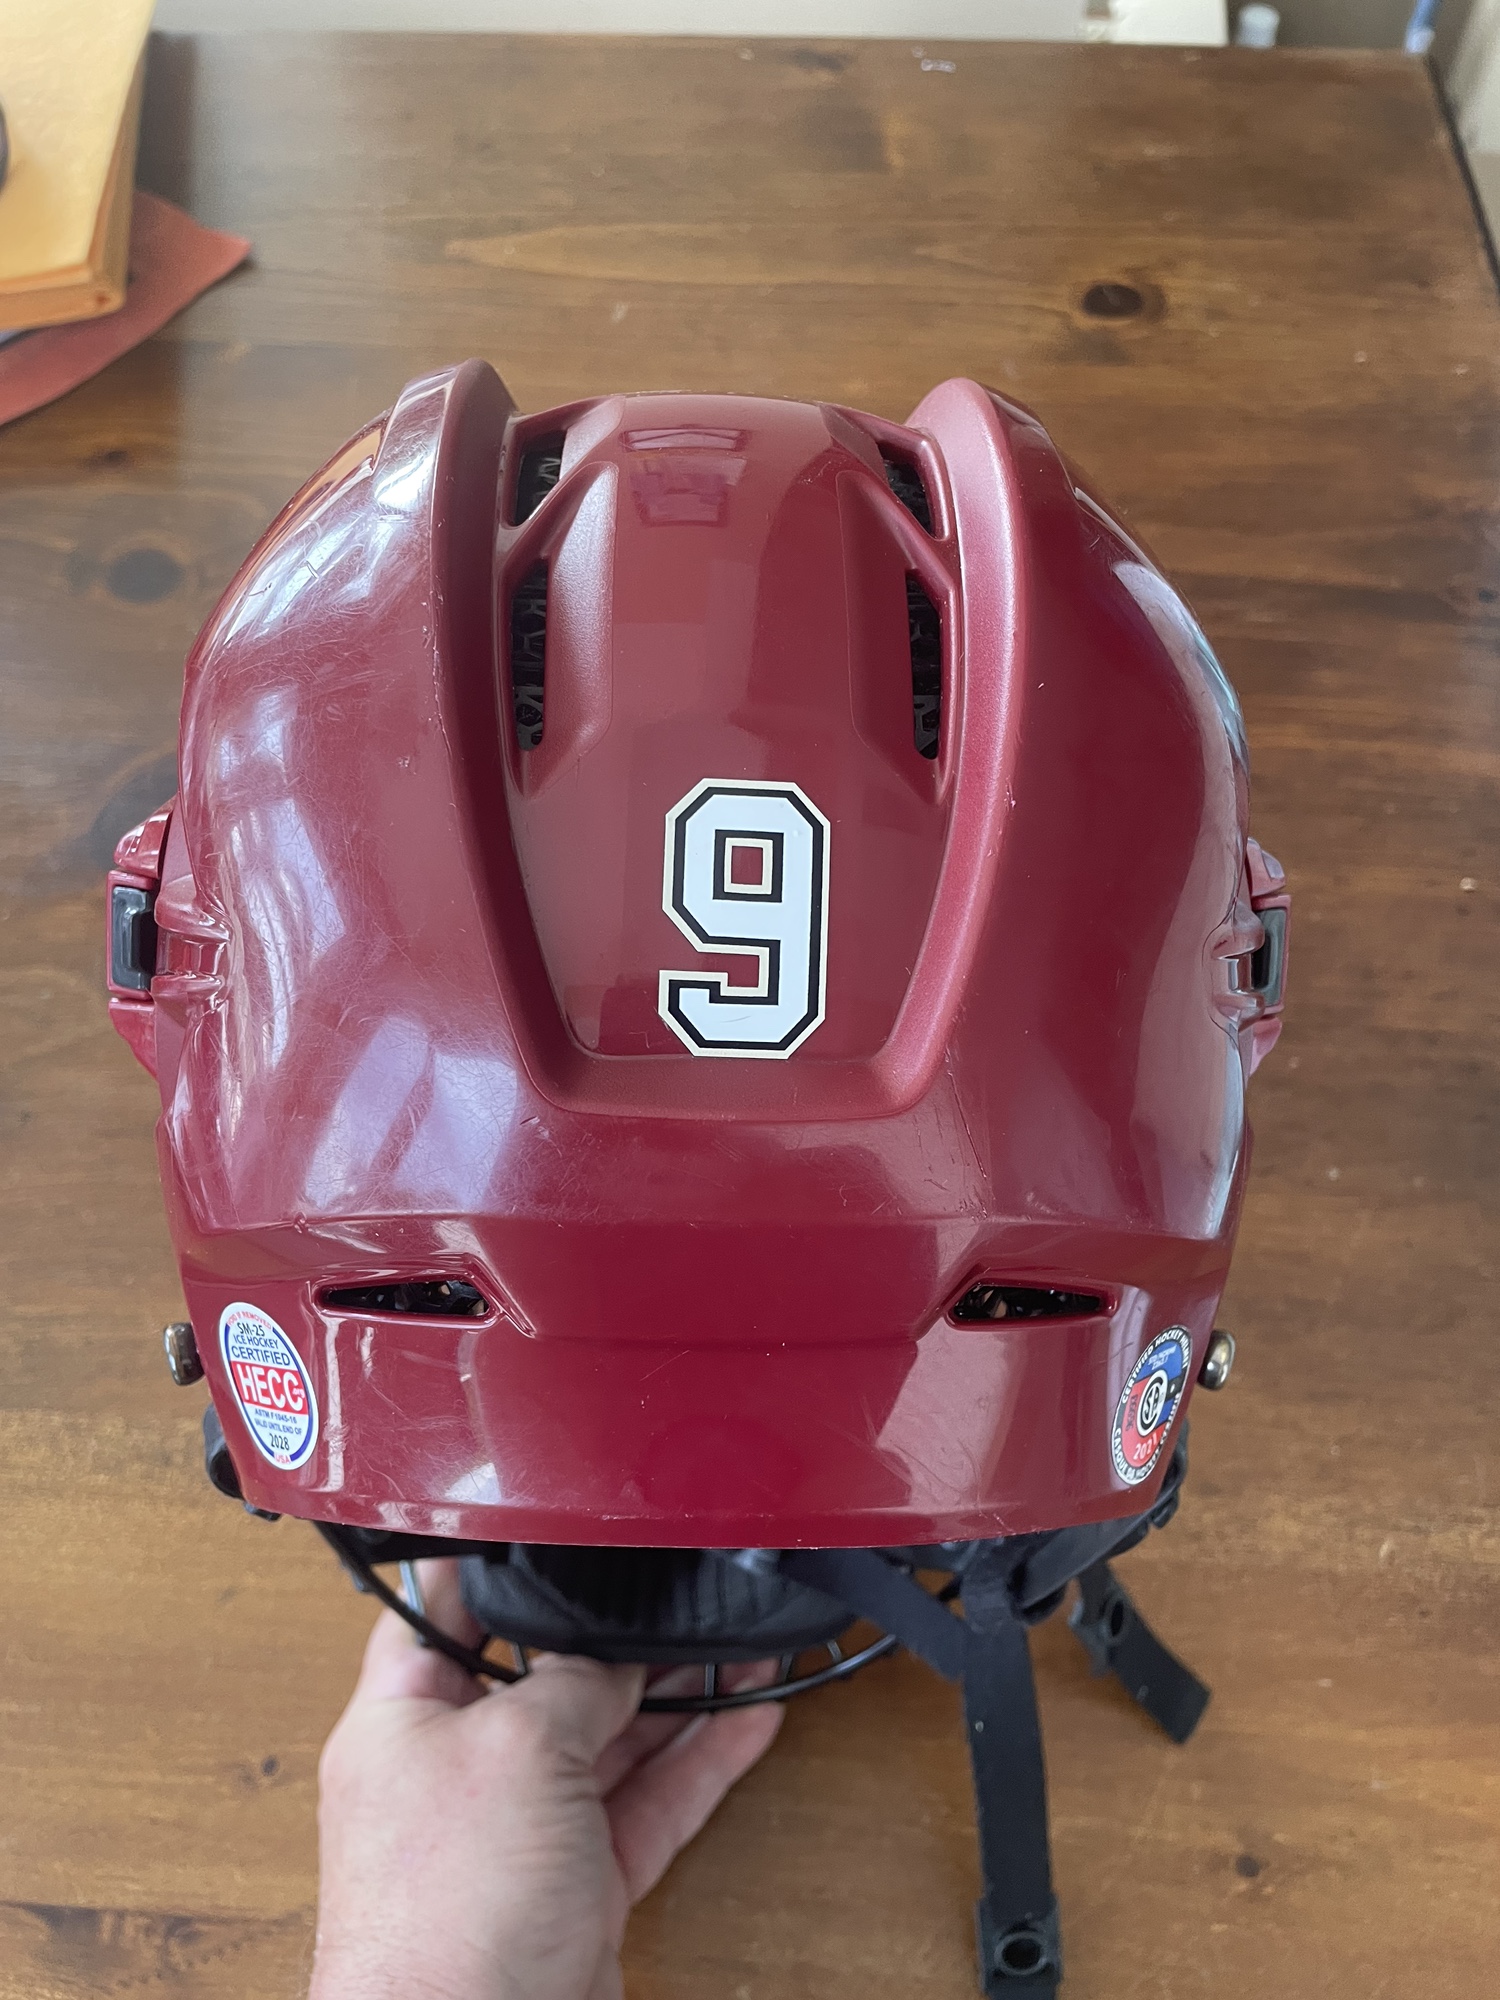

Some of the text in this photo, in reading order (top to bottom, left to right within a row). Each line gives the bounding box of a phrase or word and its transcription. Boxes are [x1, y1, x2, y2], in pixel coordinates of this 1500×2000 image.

[658, 778, 831, 1059] 9
[237, 1322, 265, 1337] SM-25
[233, 1334, 279, 1349] ICE HOCKEY
[231, 1345, 291, 1366] CERTIFIED
[1121, 1345, 1153, 1404] CERTIFIED
[1155, 1329, 1183, 1347] HOCKEY
[236, 1363, 303, 1411] HECC
[282, 1424, 294, 1434] END
[269, 1433, 290, 1451] 2028
[274, 1453, 291, 1464] USA
